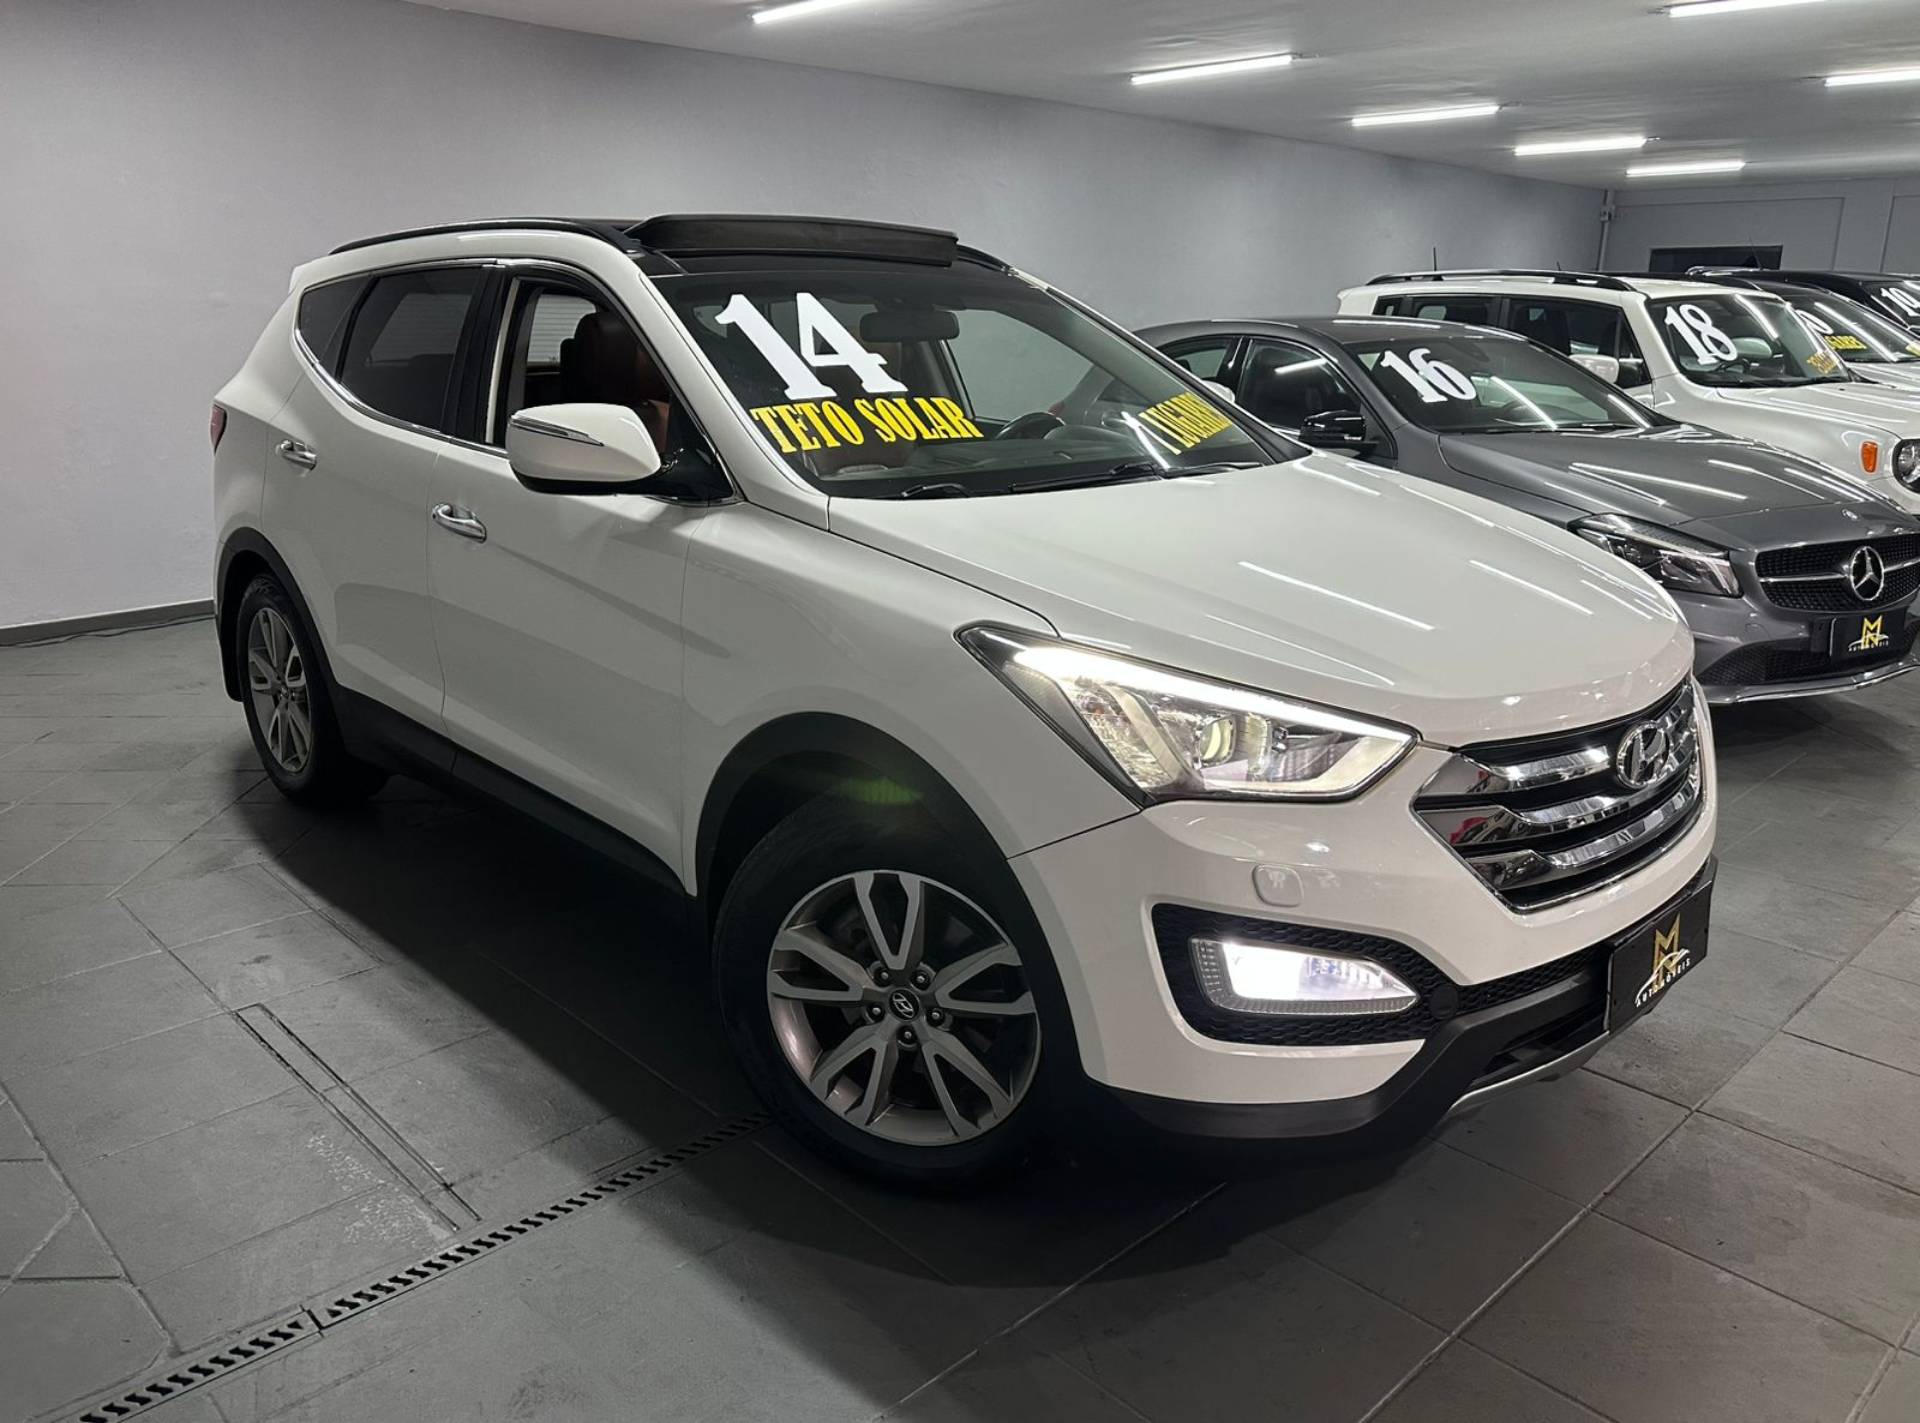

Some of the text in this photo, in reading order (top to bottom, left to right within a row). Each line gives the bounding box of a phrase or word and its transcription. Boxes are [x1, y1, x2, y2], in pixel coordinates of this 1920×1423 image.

[714, 292, 909, 400] 14
[1664, 304, 1738, 366] 18
[1380, 348, 1477, 403] 16
[750, 397, 984, 454] TETO SOLAR
